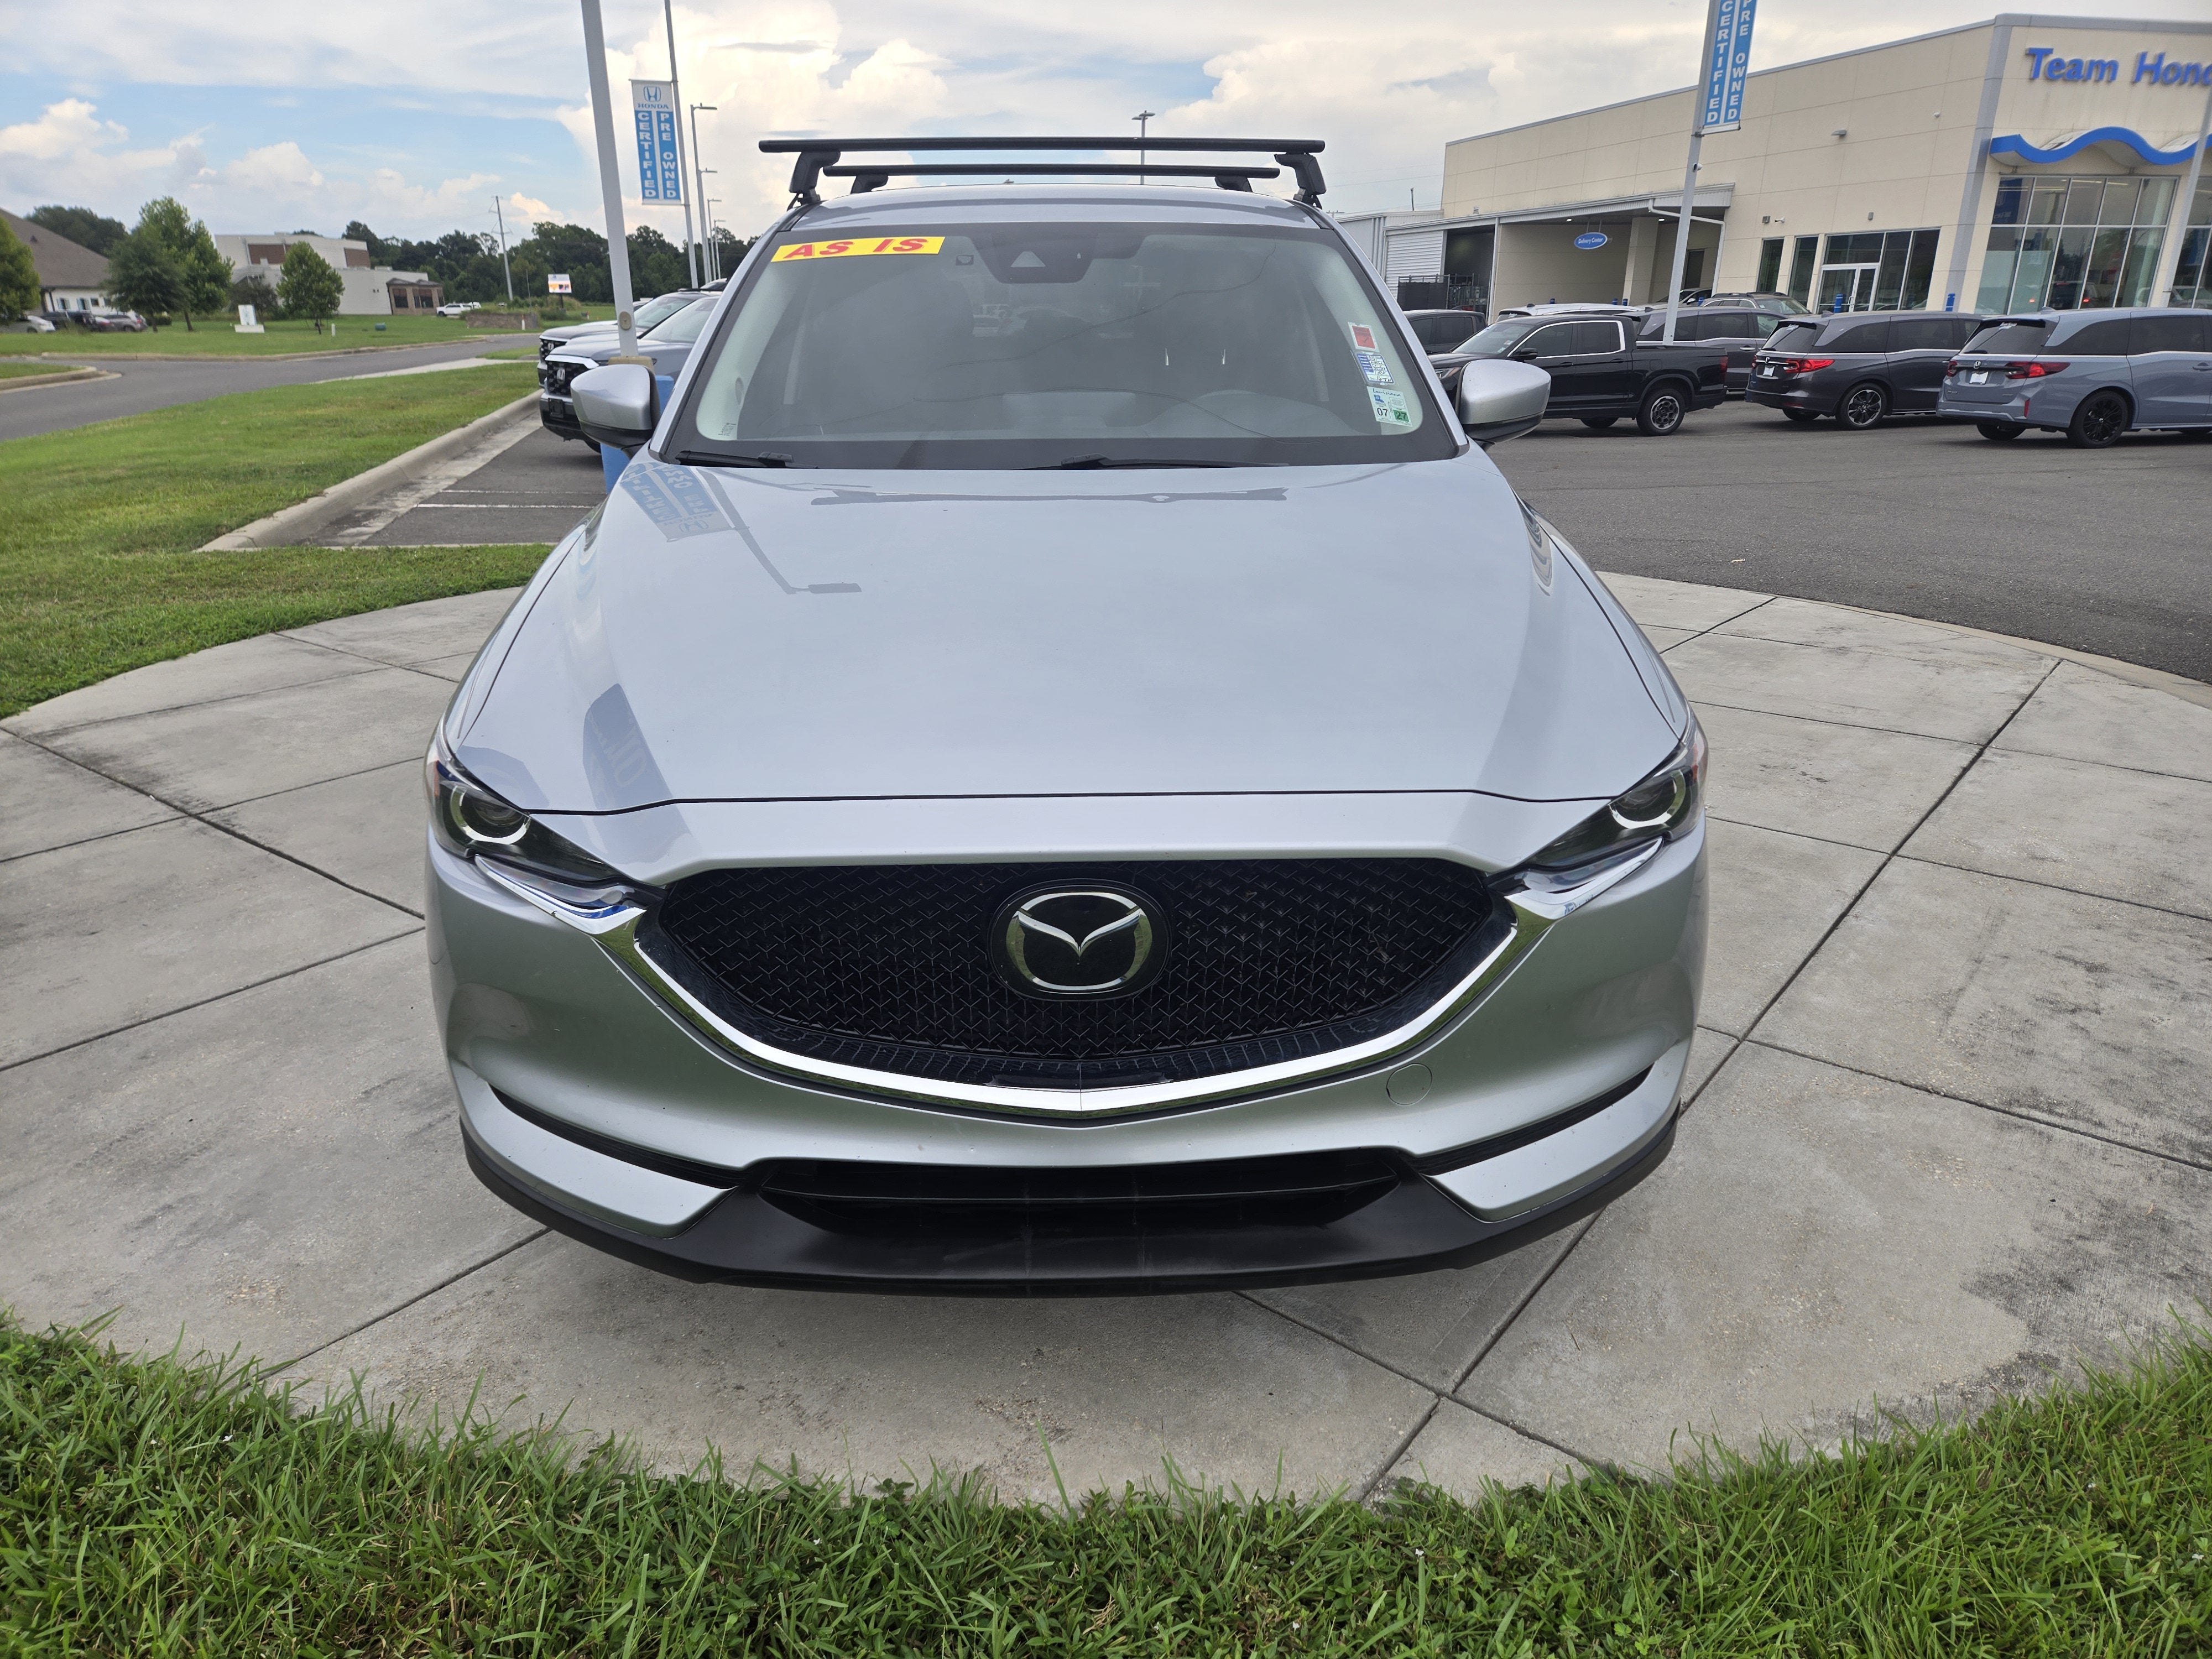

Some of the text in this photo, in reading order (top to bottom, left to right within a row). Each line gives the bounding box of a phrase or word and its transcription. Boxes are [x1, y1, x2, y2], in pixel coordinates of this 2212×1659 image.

[1707, 1, 1733, 123] CERTIFIED
[2026, 47, 2120, 82] Team
[1727, 52, 1746, 120] OWNED
[637, 112, 657, 198] CERTIFIED
[660, 112, 676, 198] PRE OWNED
[782, 238, 929, 259] AS IS
[1373, 388, 1402, 397] Louisiana
[1376, 407, 1389, 417] 07
[1395, 411, 1407, 421] 27
